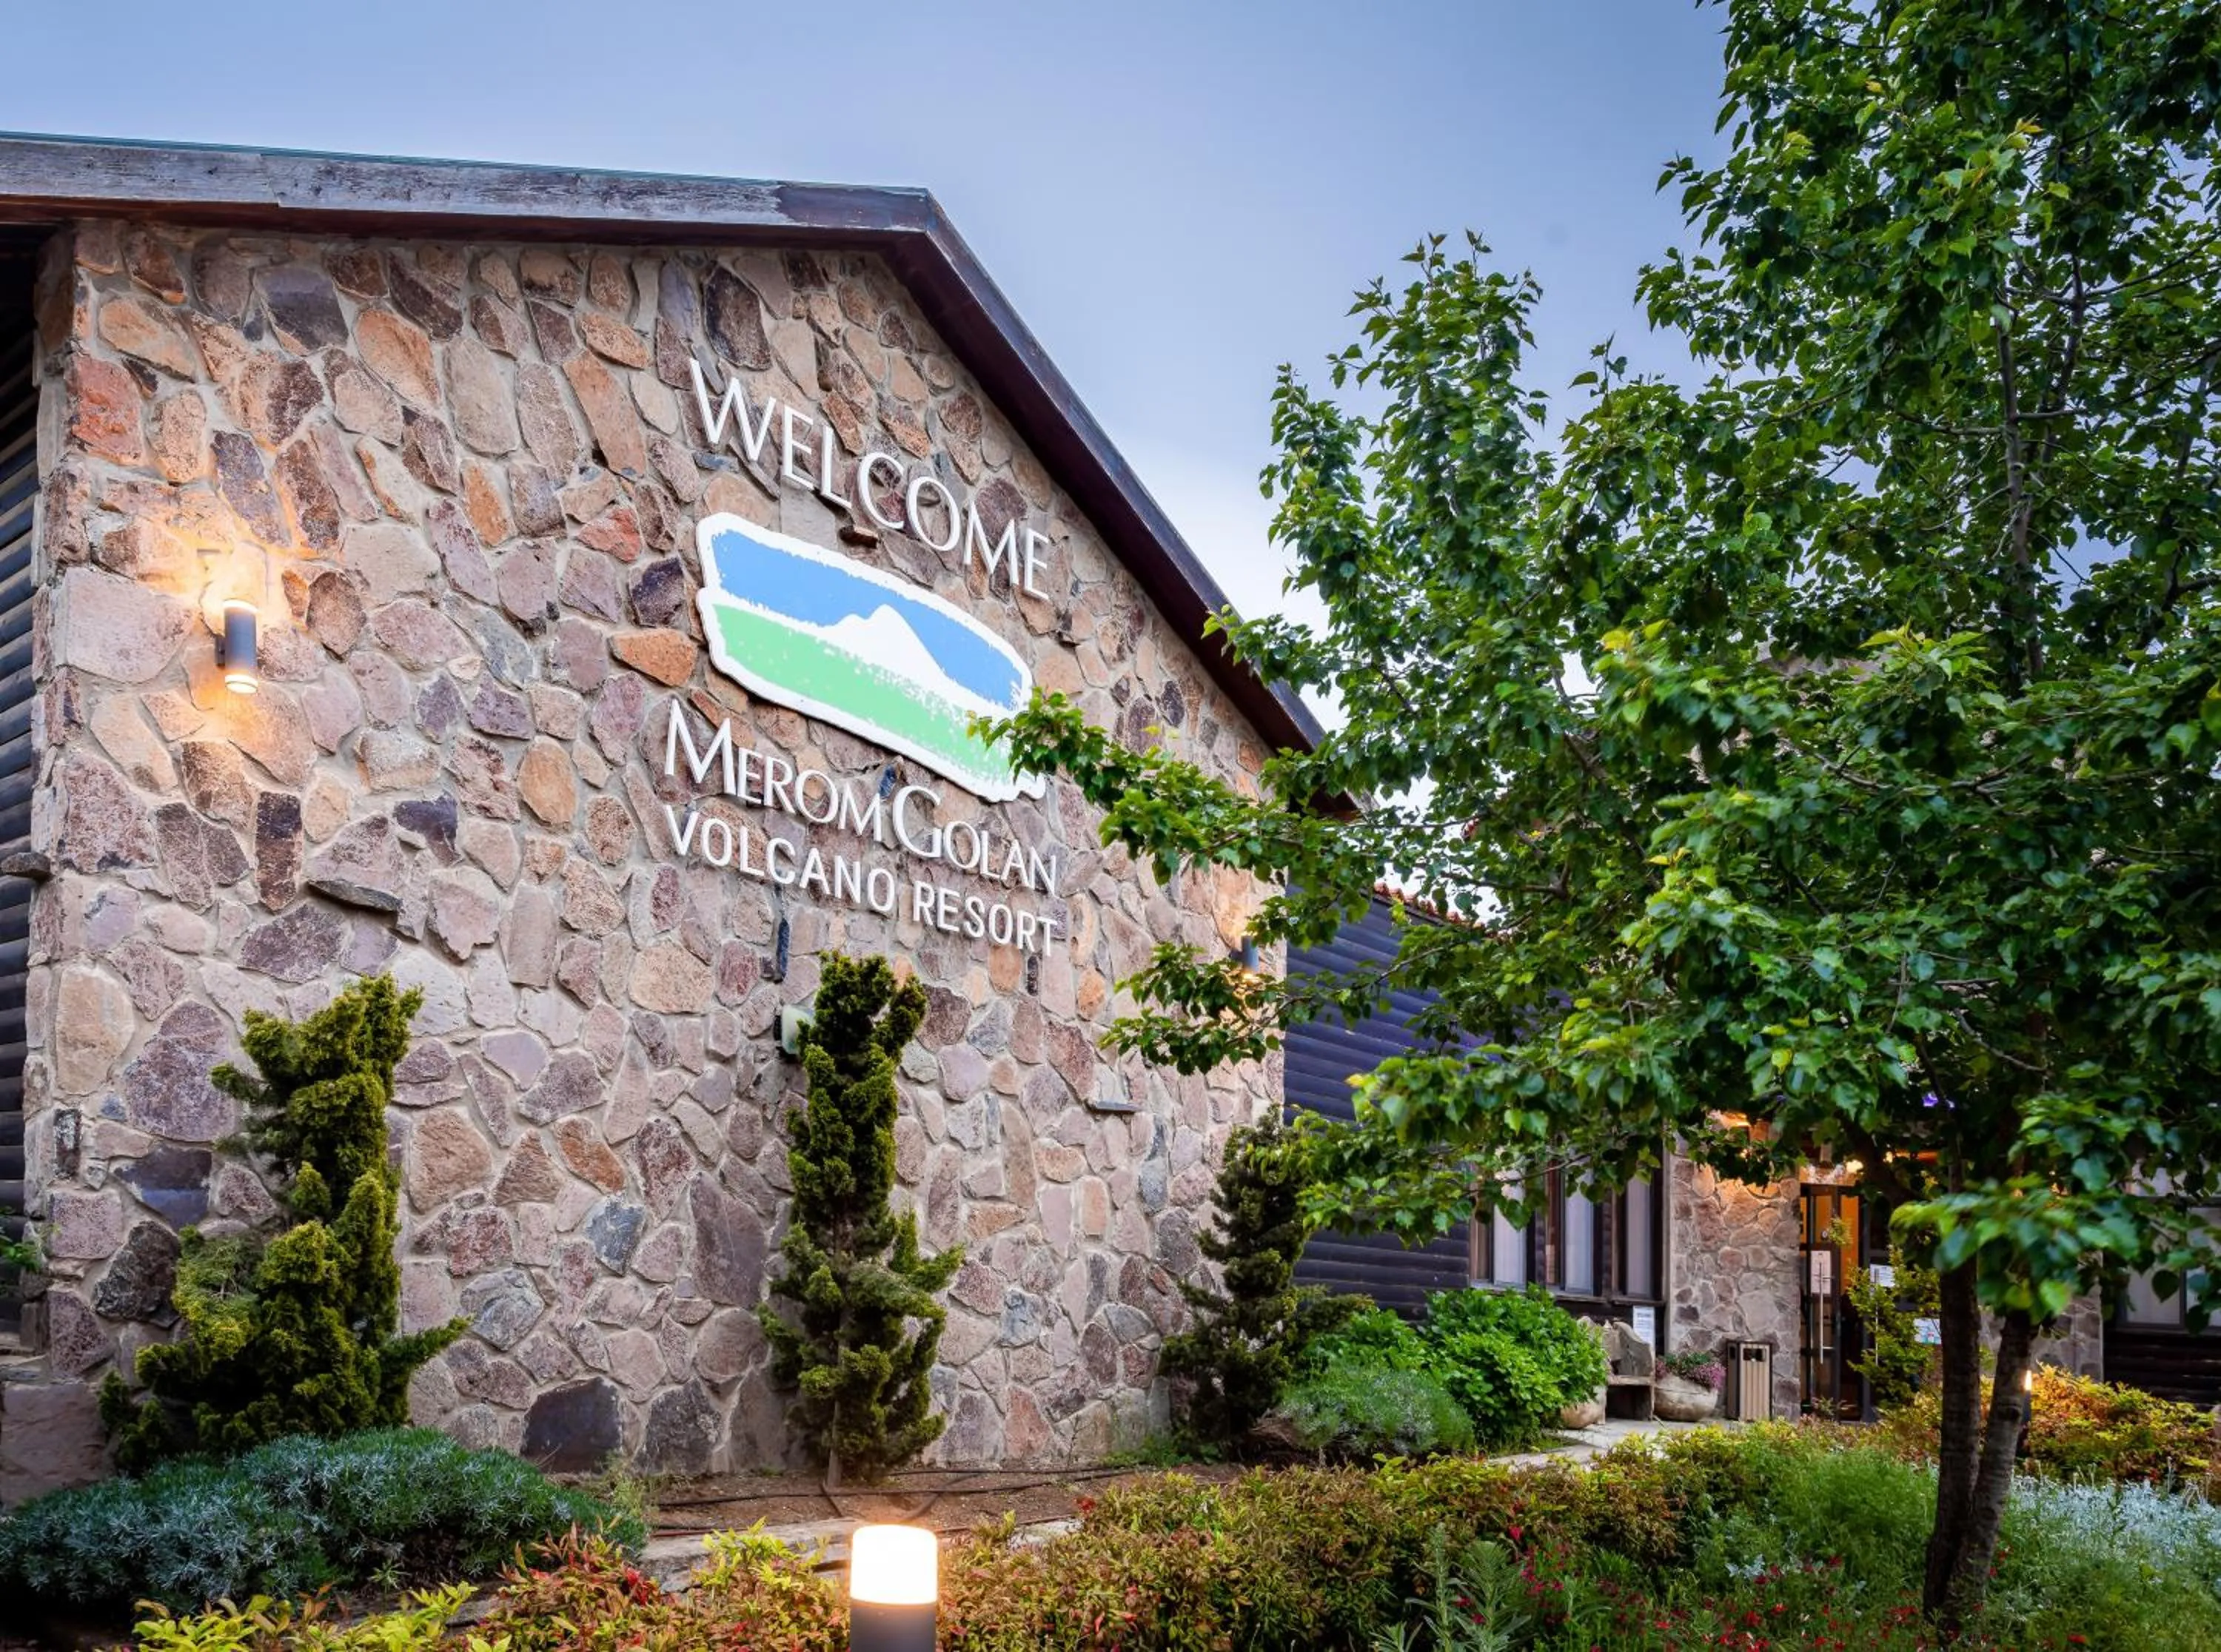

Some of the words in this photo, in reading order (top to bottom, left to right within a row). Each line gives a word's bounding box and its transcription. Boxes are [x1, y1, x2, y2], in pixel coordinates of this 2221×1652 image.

[689, 358, 1051, 601] WELCOME
[663, 805, 895, 913] VOLCANO
[913, 880, 1058, 956] RESORT
